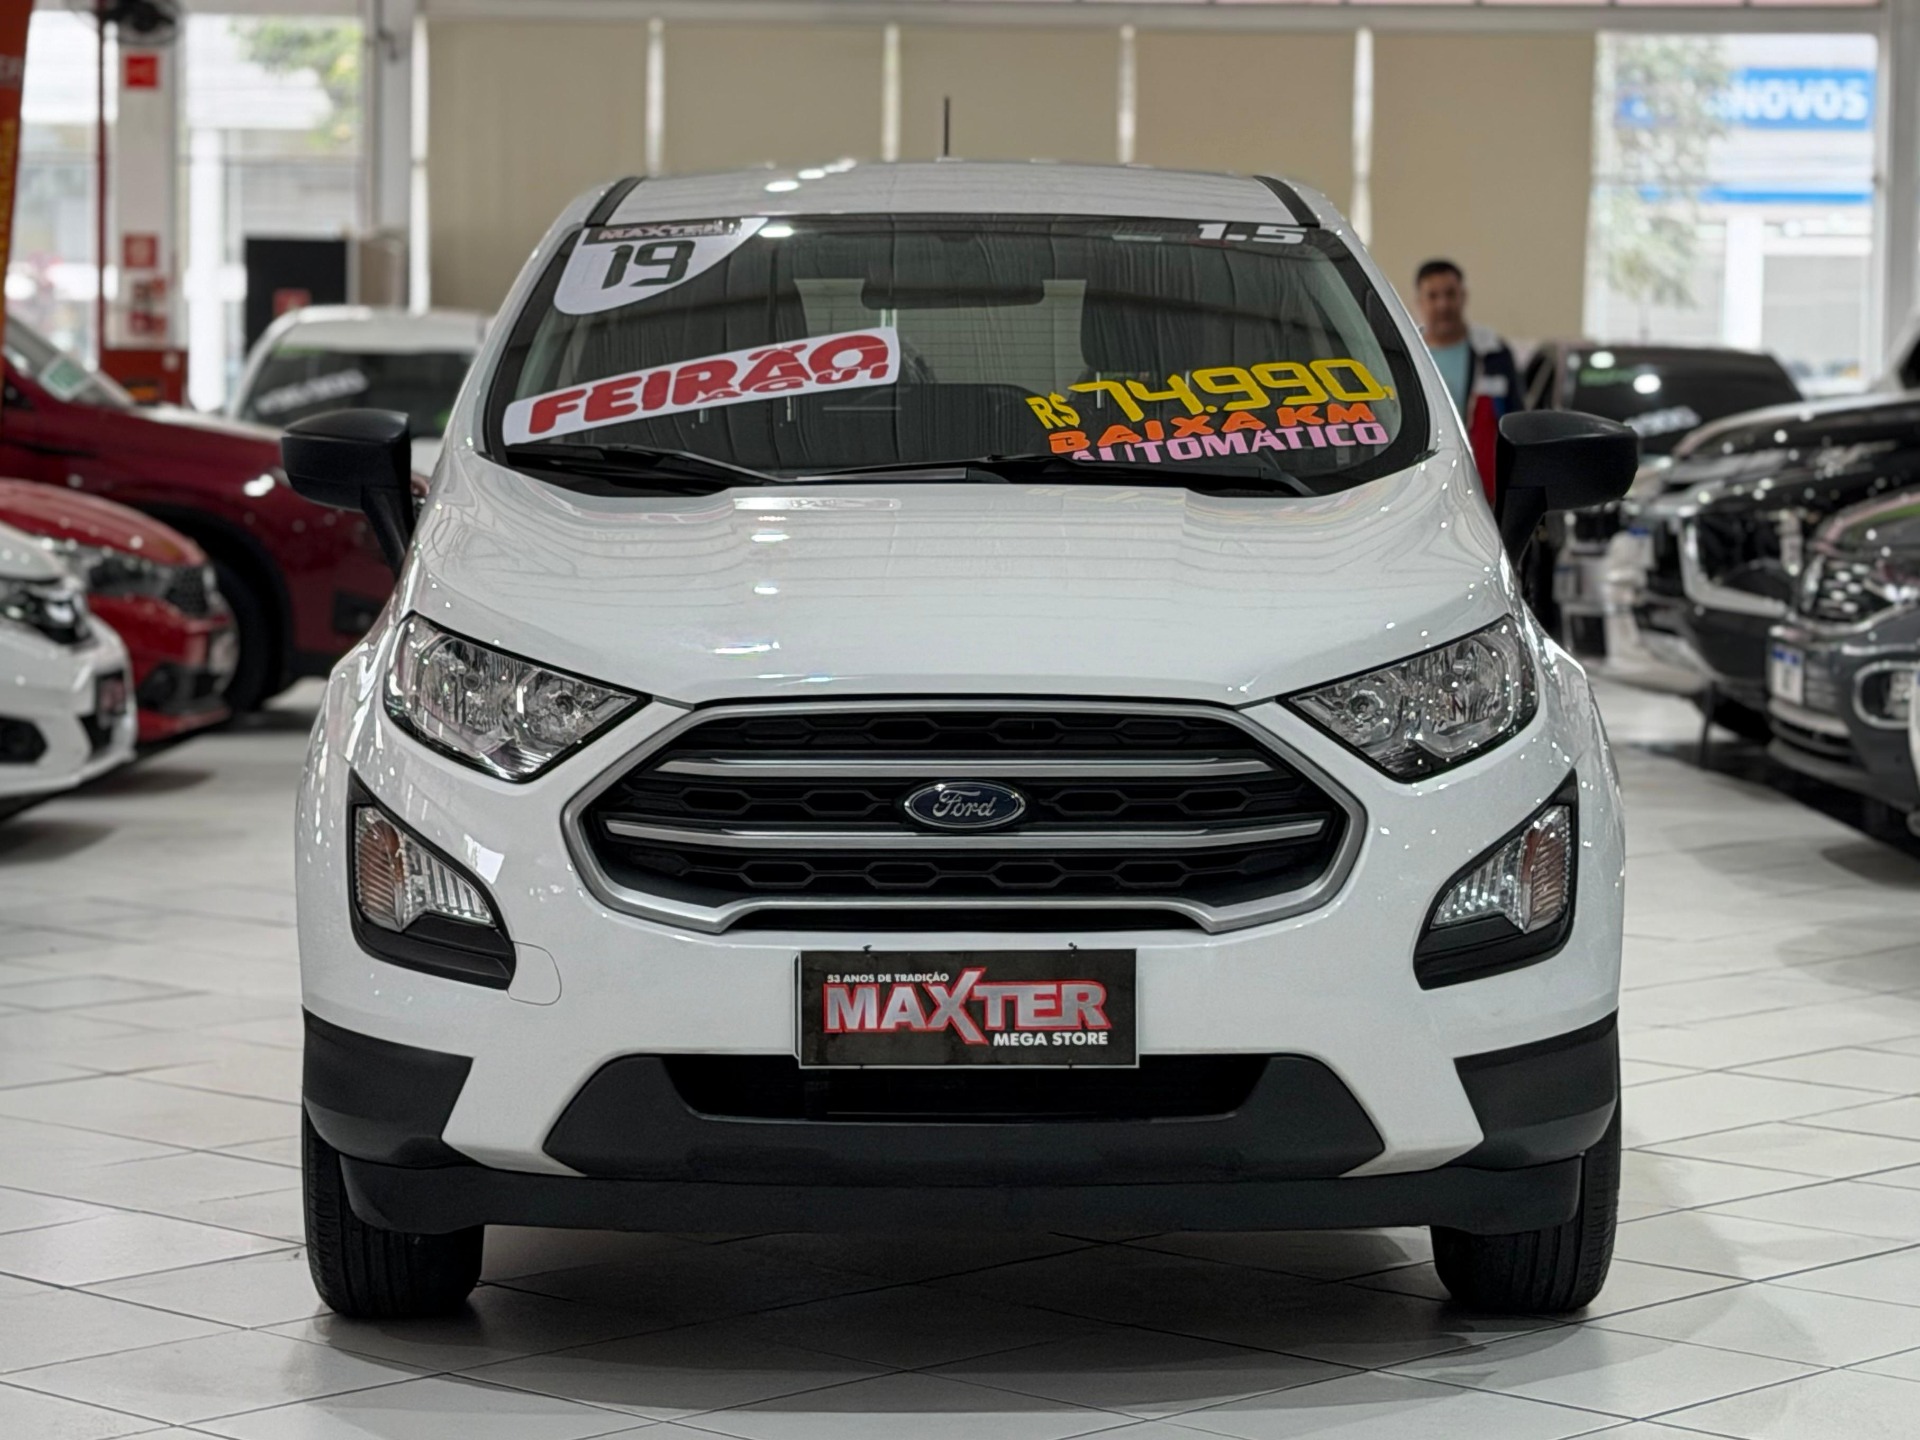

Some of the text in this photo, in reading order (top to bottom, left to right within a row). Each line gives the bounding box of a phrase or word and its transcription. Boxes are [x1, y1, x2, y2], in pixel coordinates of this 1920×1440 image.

[1198, 223, 1308, 244] 1.5
[601, 240, 696, 290] 19
[529, 335, 889, 434] FEIRÃO
[1048, 402, 1377, 454] BAIXA KM
[932, 789, 998, 818] Ford
[842, 974, 875, 983] ANOS
[877, 973, 892, 983] DE
[894, 971, 950, 984] TRADIÇÃO
[823, 967, 1113, 1046] MAXTER
[993, 1031, 1109, 1047] MEGA STORE
